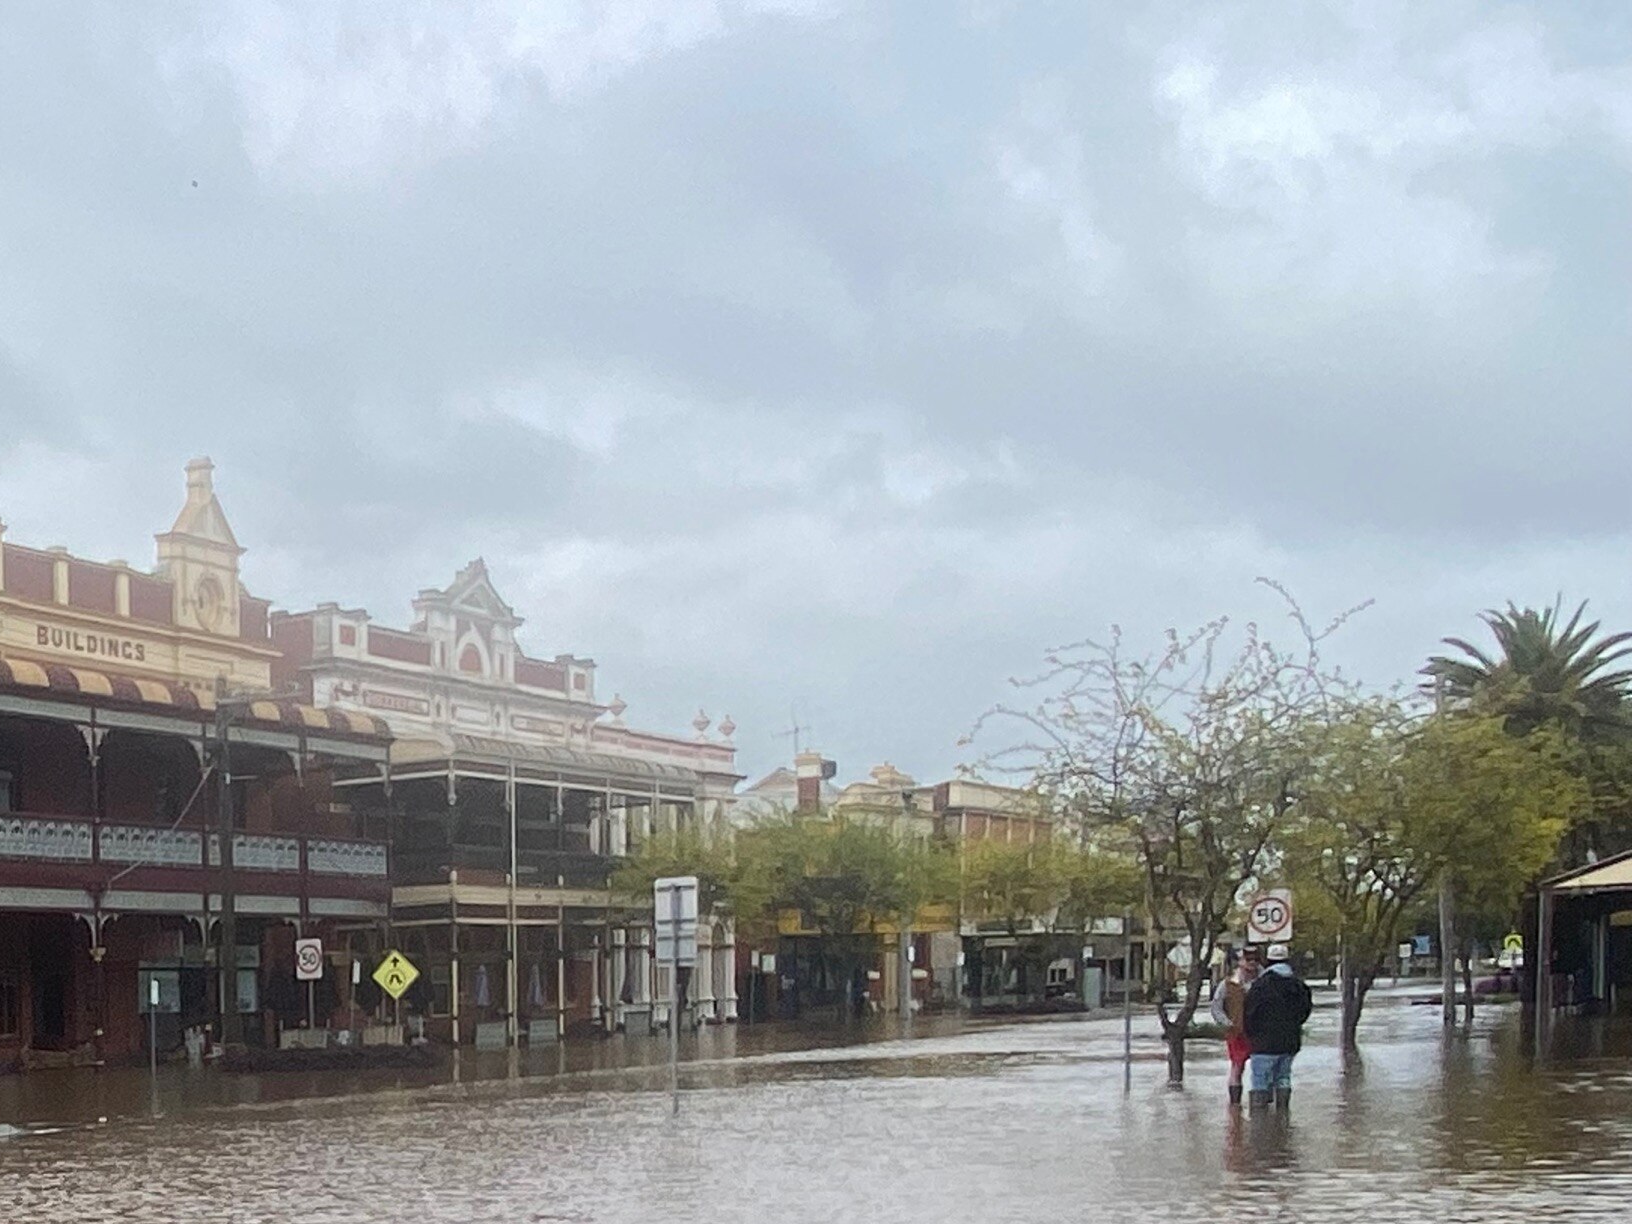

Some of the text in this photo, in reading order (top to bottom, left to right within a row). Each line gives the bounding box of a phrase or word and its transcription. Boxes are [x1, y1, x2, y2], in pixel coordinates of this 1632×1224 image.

[36, 624, 145, 661] BUILDINGS
[1256, 907, 1284, 925] 50
[302, 952, 317, 966] 50
